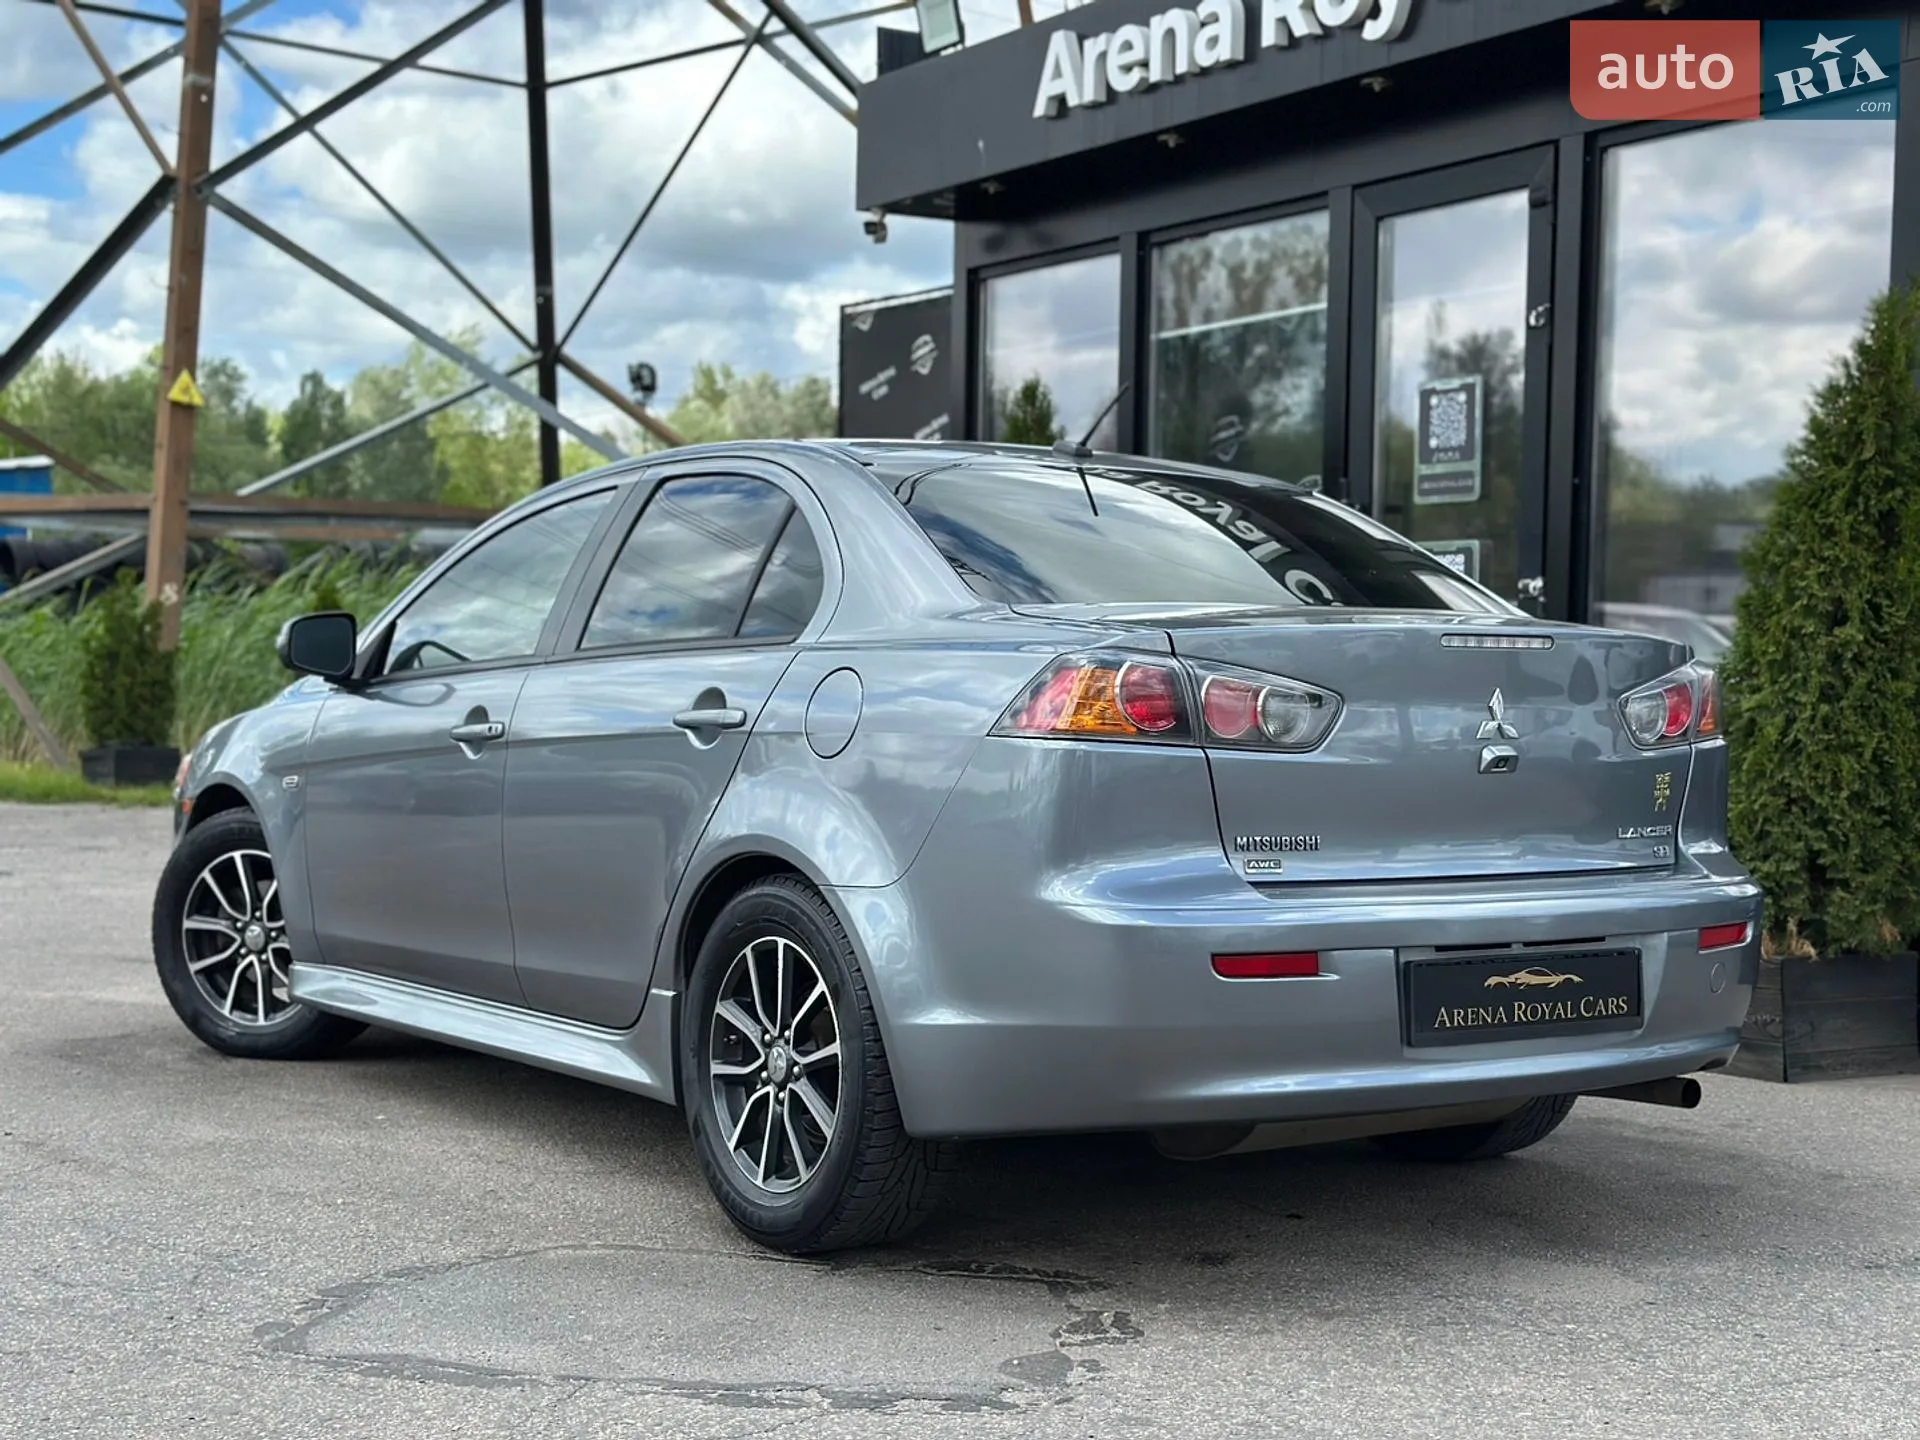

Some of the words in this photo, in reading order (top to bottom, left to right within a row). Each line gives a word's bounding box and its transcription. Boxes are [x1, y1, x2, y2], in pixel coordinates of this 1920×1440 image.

[1032, 0, 1245, 118] Arena
[1618, 825, 1672, 838] LANCER
[1234, 835, 1321, 851] MITSUBISHI
[1249, 860, 1280, 868] AWC
